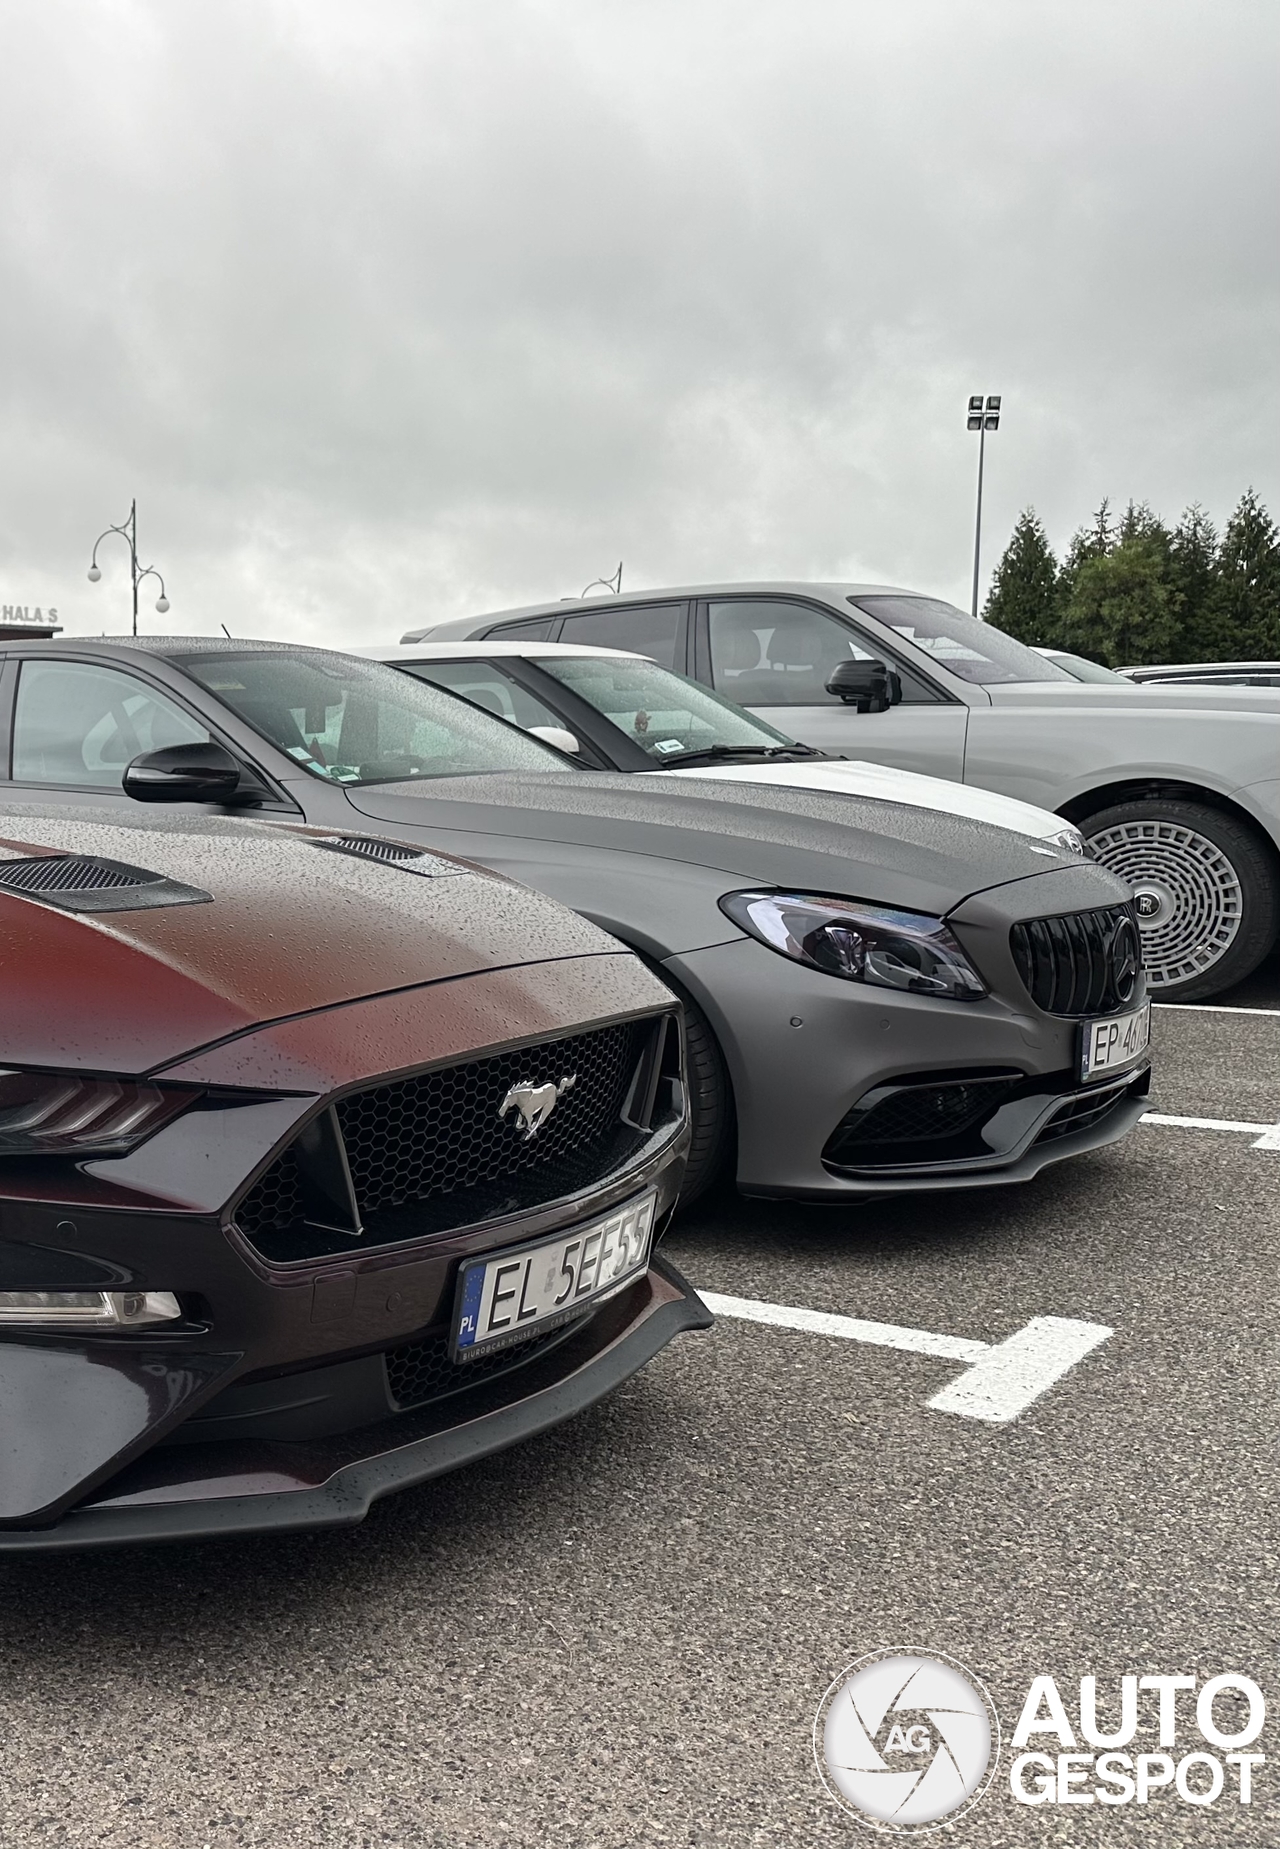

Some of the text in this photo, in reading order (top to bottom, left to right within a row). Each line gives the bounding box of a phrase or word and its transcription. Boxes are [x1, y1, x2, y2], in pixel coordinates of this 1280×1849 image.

[2, 604, 43, 622] HALA
[1094, 1022, 1119, 1067] EP
[486, 1202, 650, 1332] EL 5EF55
[459, 1314, 475, 1336] PL
